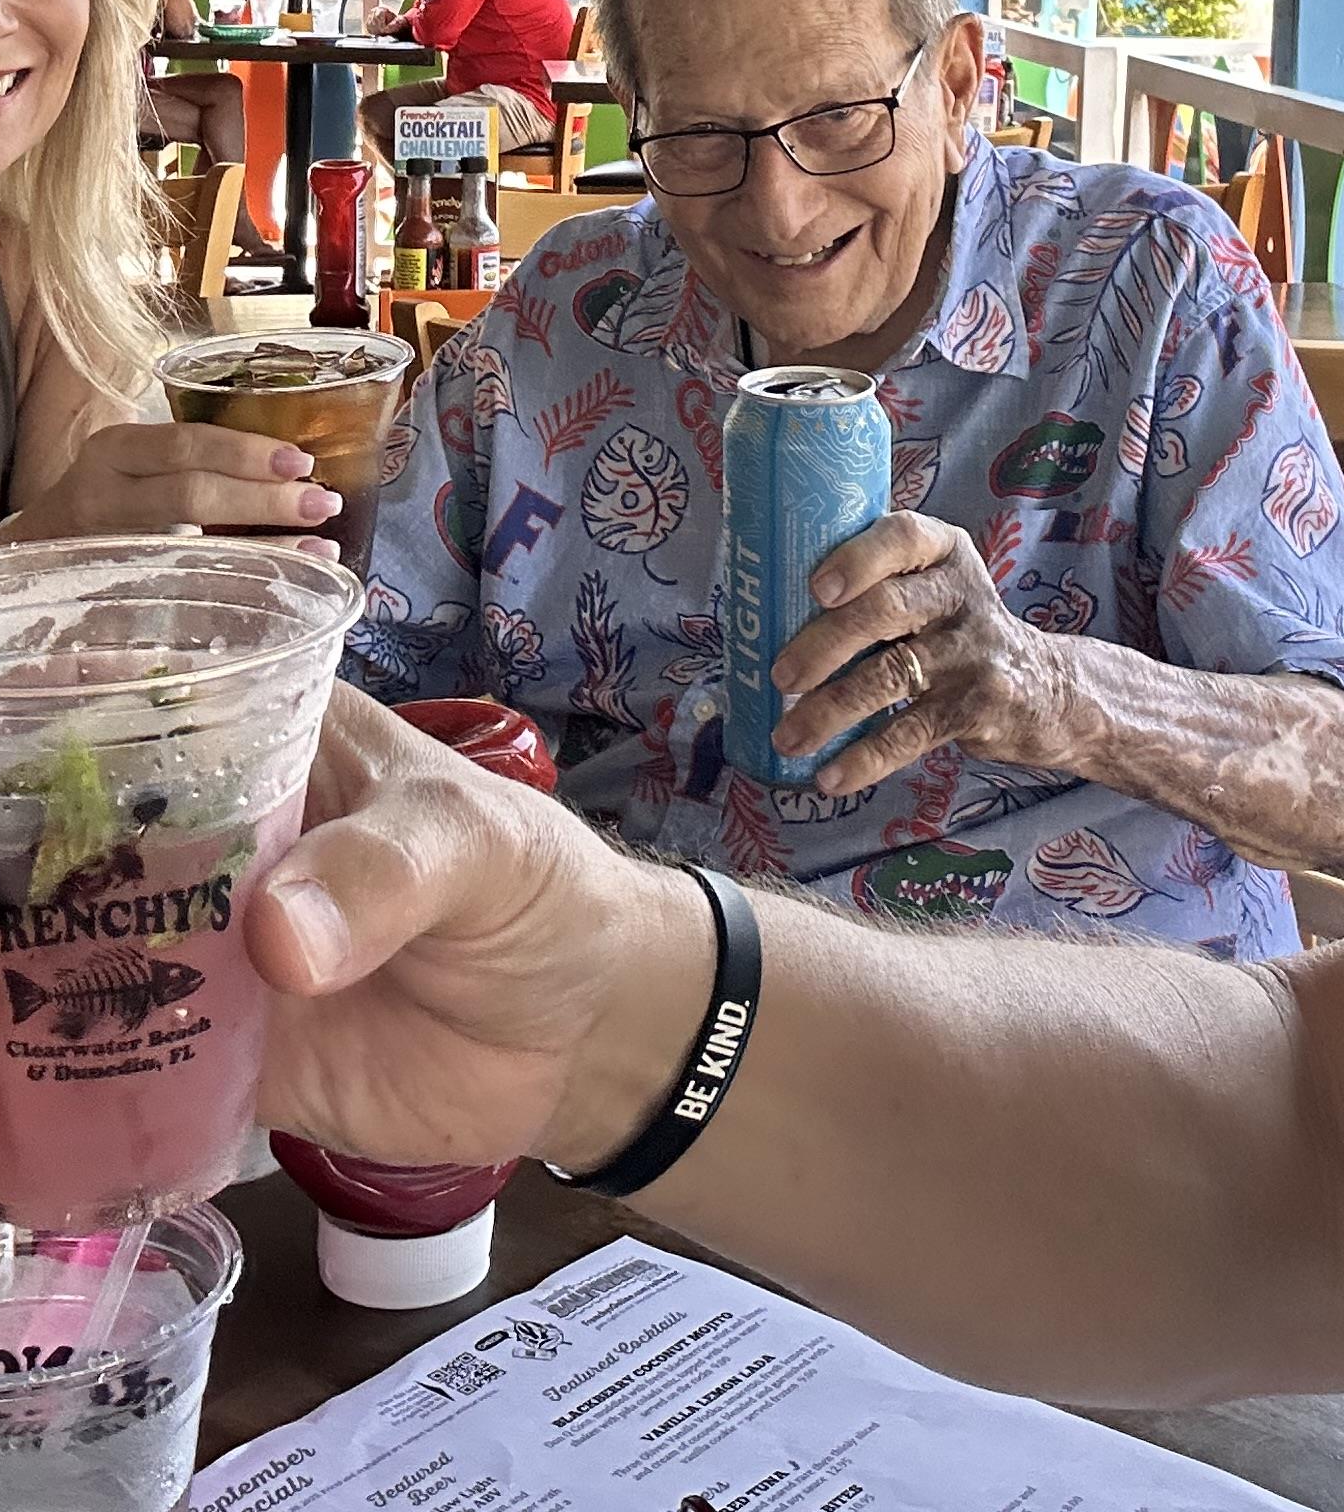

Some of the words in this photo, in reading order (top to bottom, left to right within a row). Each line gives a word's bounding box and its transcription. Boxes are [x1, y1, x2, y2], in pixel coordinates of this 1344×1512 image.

[400, 109, 445, 121] Frenchy's
[400, 120, 485, 138] COCKTAIL
[400, 139, 485, 160] CHALLENGE
[736, 537, 762, 690] LIGHT
[7, 1030, 142, 1059] Clearwater
[147, 1016, 212, 1048] Beach
[169, 1044, 196, 1065] FL
[674, 1080, 719, 1121] BE
[542, 1352, 620, 1402] Featured
[612, 1312, 688, 1355] Cocktails
[551, 1374, 635, 1428] BLACKBERRY
[632, 1338, 691, 1377] COCONUT
[686, 1312, 734, 1342] MOJITO
[640, 1406, 700, 1441] VANILLA
[695, 1376, 743, 1406] LEMON
[738, 1355, 776, 1378] LADA
[192, 1448, 316, 1512] eptember
[366, 1451, 454, 1508] Featured
[407, 1476, 457, 1506] Beer
[458, 1476, 498, 1499] Light
[745, 1471, 790, 1497] TUNA
[474, 1488, 502, 1508] ABV
